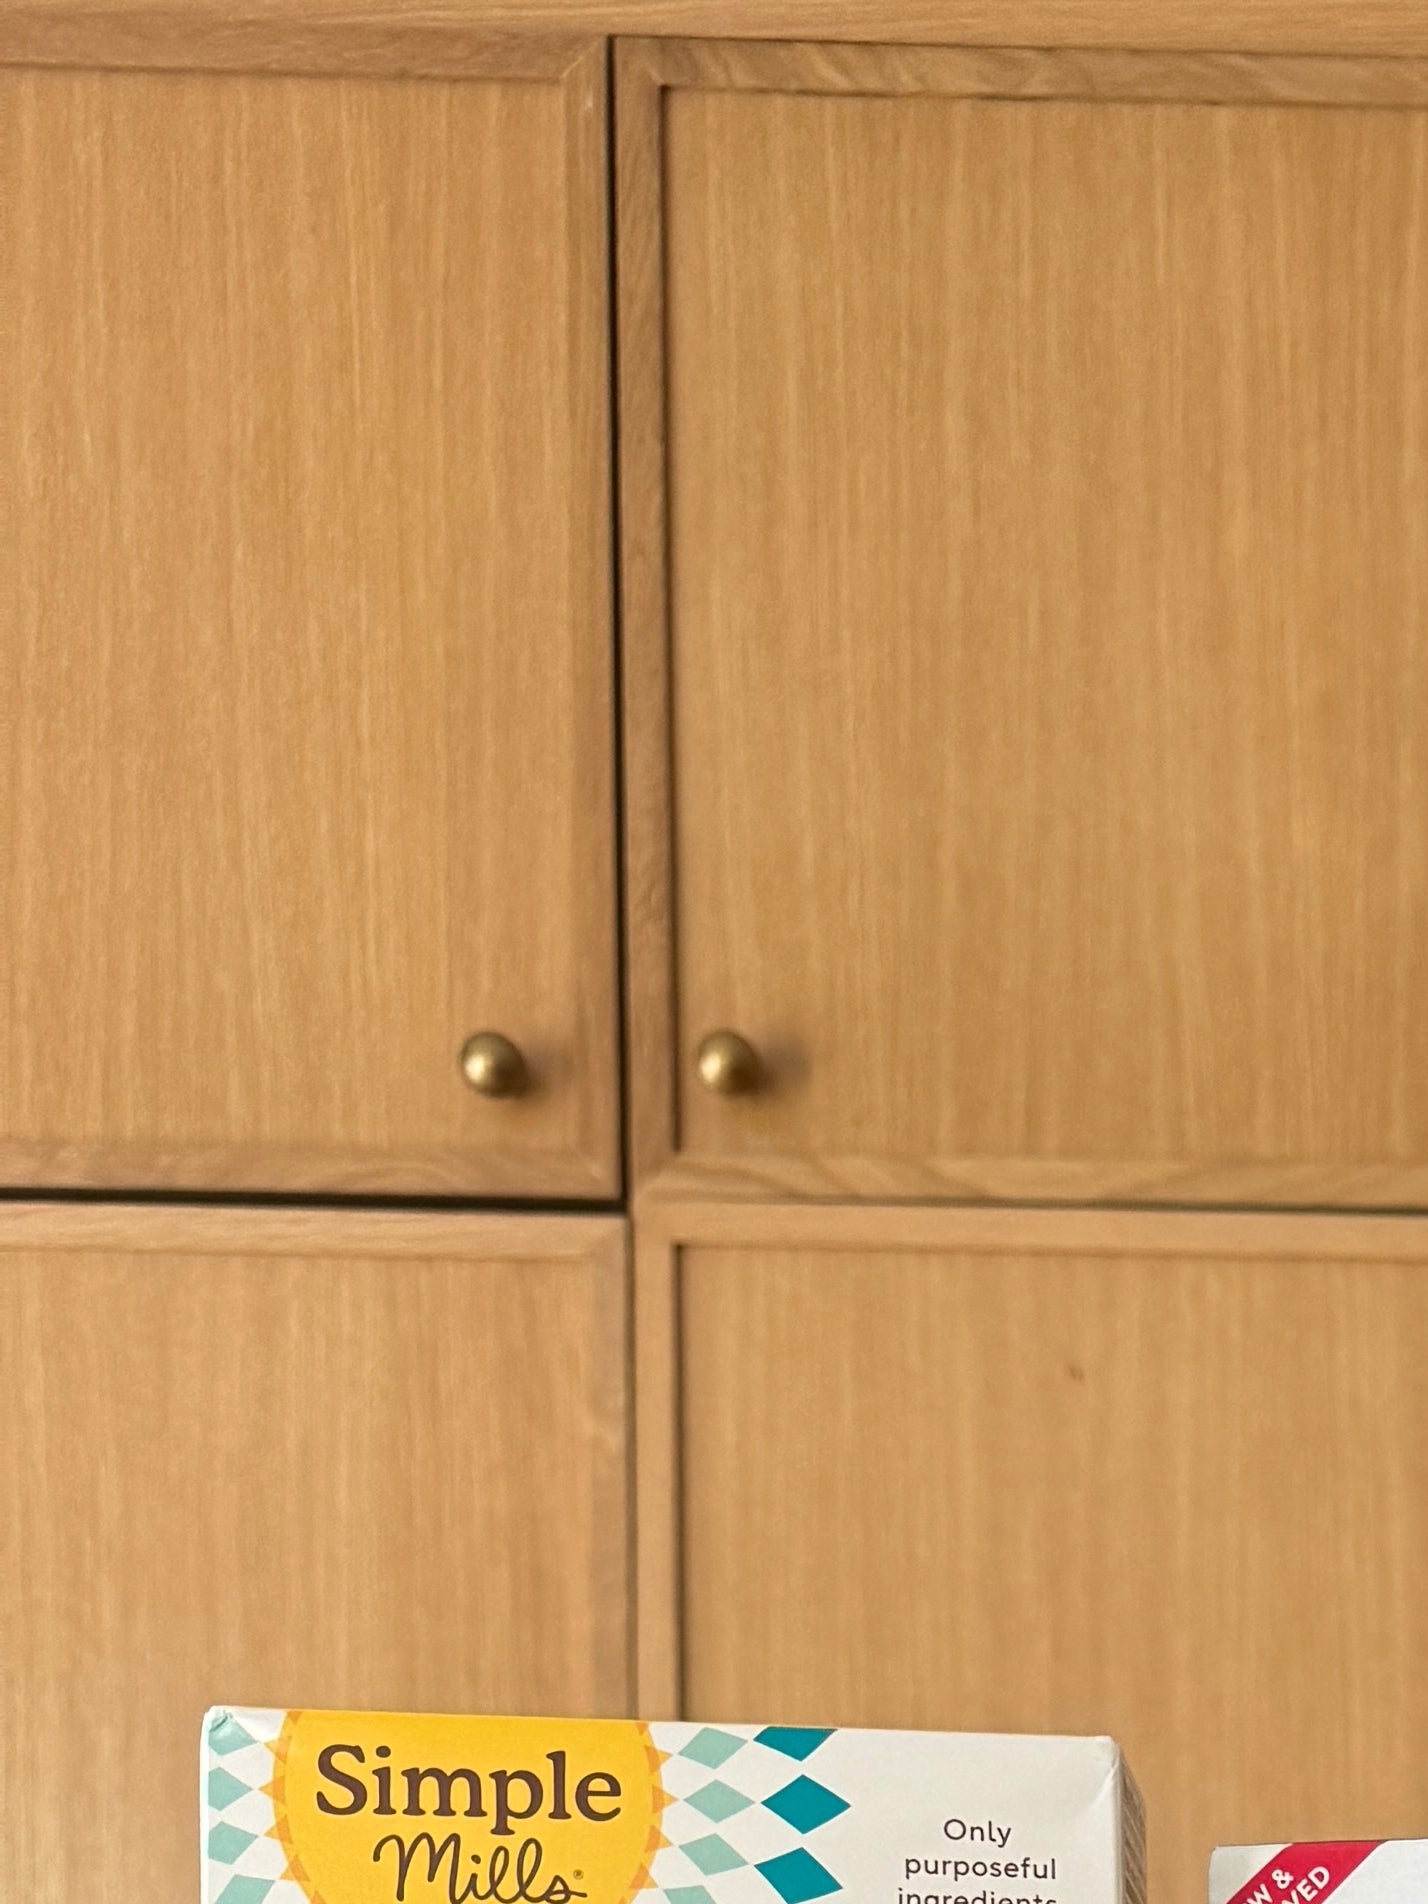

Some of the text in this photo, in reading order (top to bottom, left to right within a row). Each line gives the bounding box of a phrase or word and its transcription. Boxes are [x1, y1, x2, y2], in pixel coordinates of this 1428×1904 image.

[315, 1744, 622, 1834] Simple
[944, 1819, 1011, 1848] Only
[905, 1857, 1056, 1882] purposeful
[1272, 1868, 1294, 1889] &
